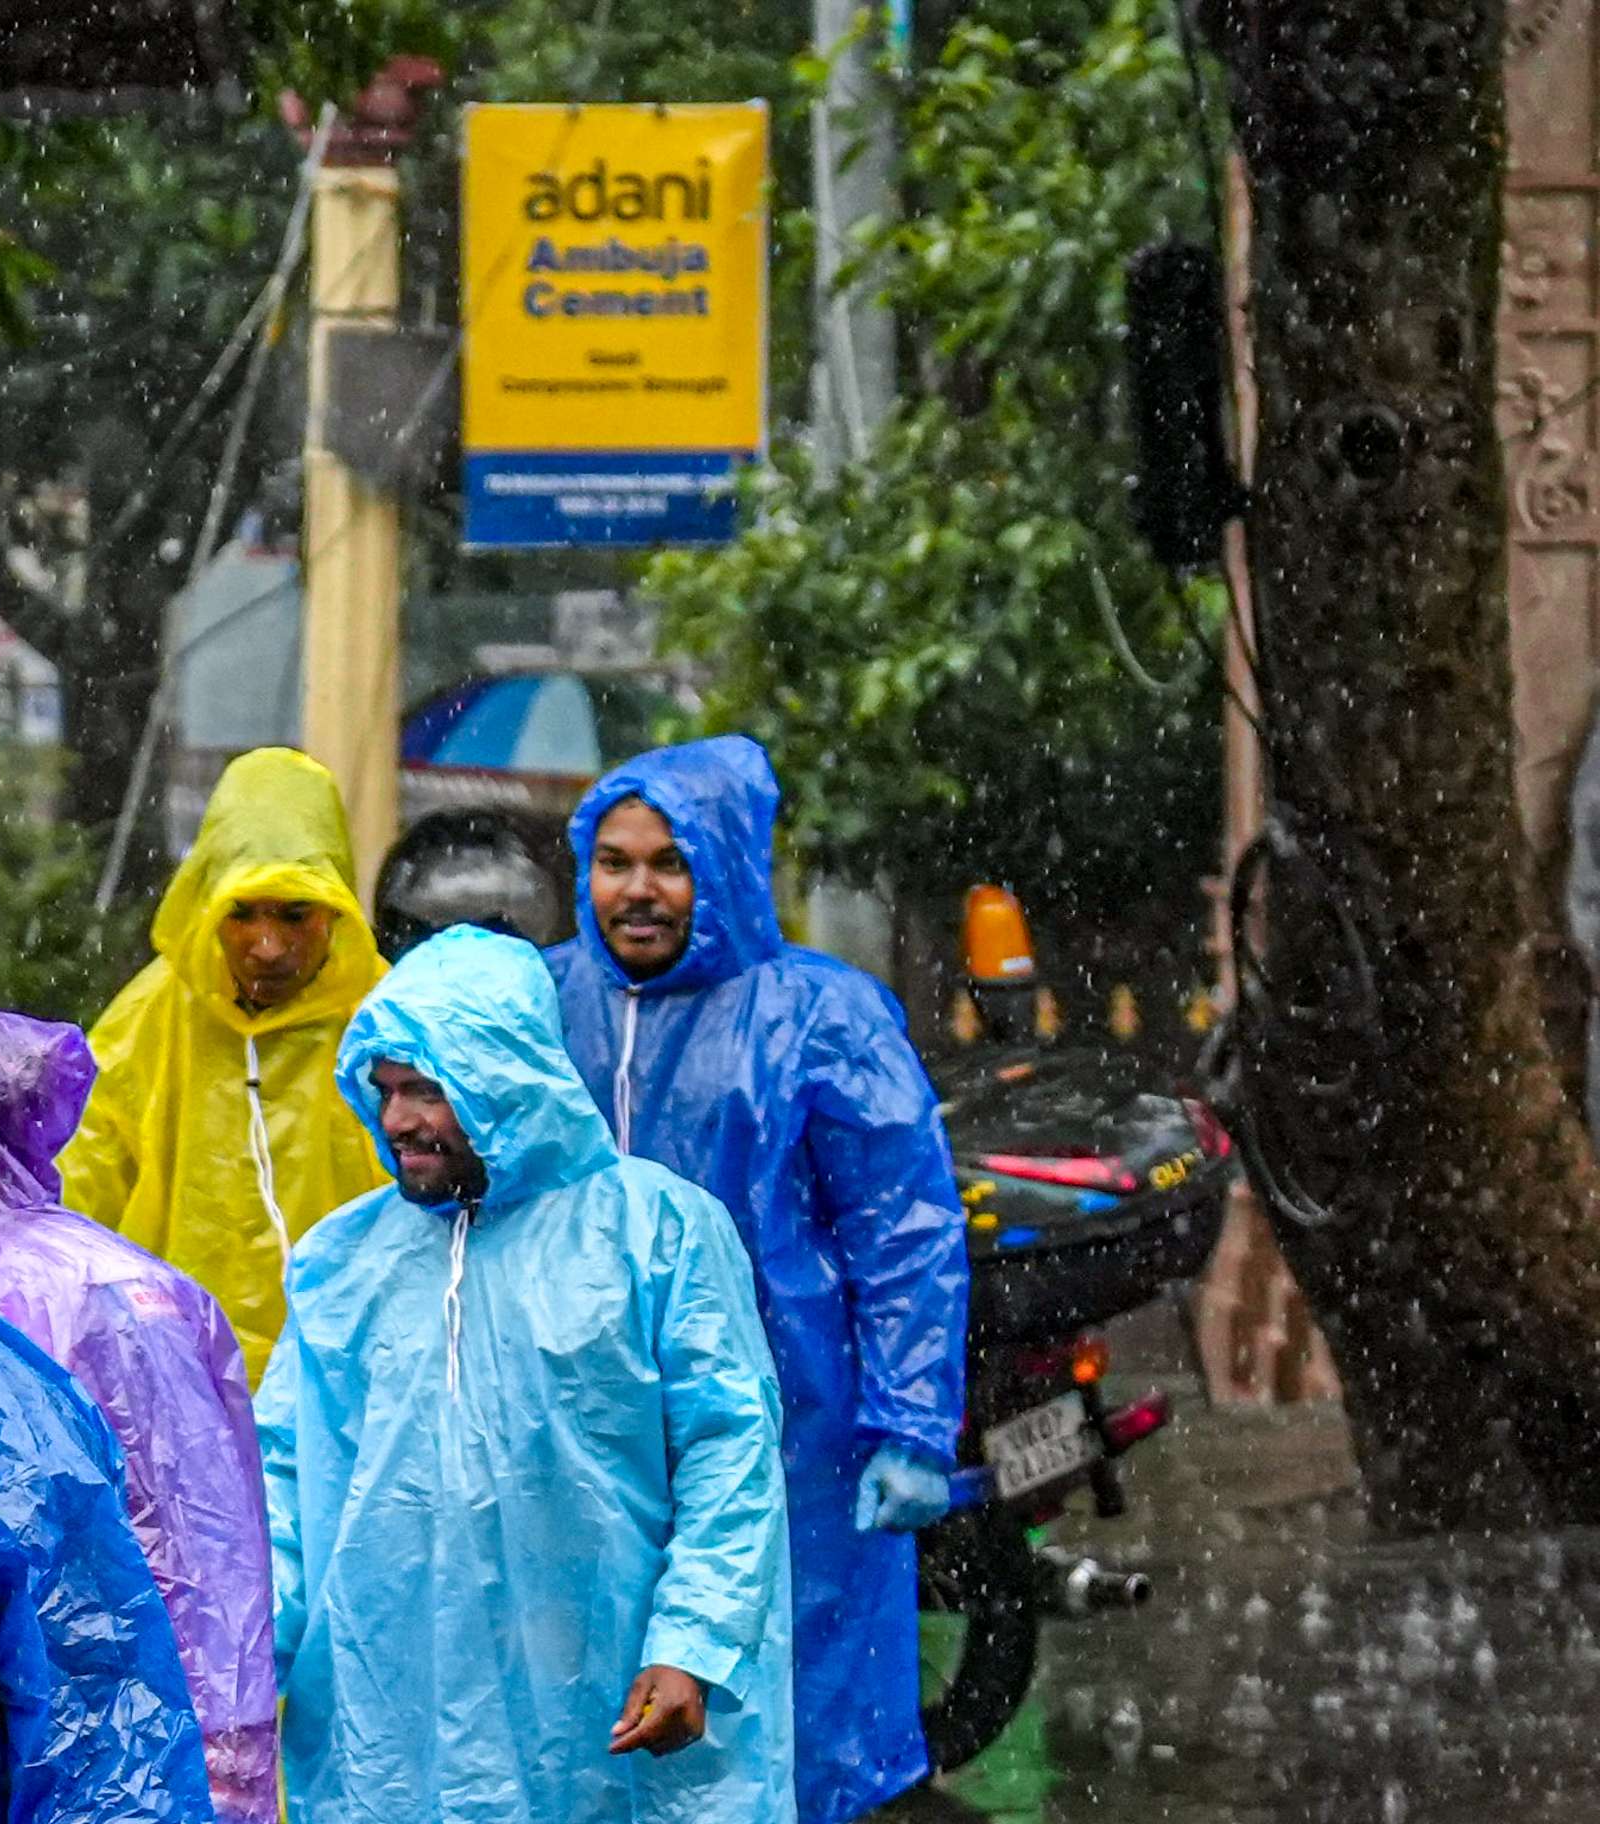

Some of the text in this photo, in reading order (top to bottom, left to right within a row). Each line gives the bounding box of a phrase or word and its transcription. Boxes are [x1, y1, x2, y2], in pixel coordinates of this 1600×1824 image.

[524, 156, 712, 222] adani
[527, 234, 711, 282] Ambuja
[524, 278, 710, 319] Cement
